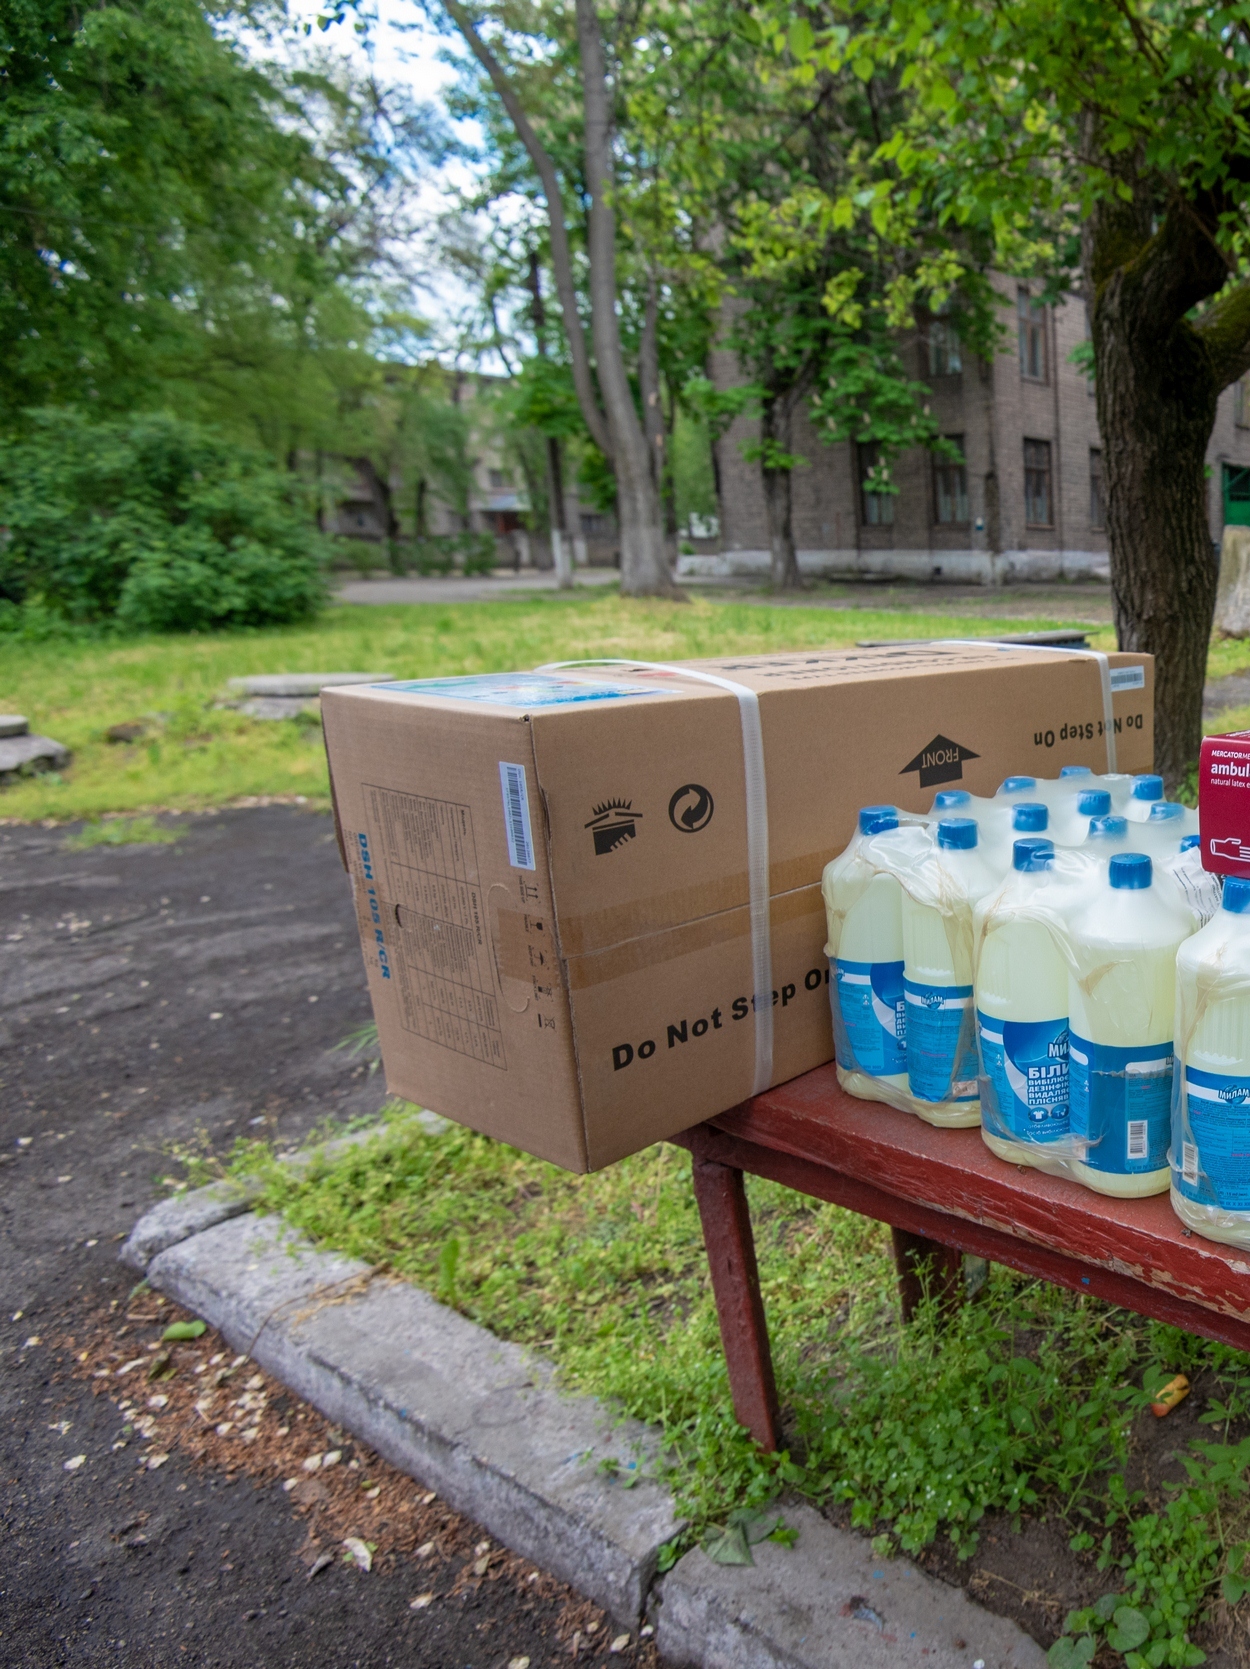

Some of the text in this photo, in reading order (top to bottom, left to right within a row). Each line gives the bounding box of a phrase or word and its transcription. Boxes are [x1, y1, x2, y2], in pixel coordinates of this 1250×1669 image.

[1060, 722, 1094, 741] Step
[1126, 714, 1143, 730] Do
[1034, 730, 1055, 748] On
[921, 747, 960, 769] FRONT
[1210, 778, 1231, 787] natural
[1232, 780, 1246, 789] latex
[356, 832, 377, 881] DSH
[366, 885, 382, 925] 105
[373, 929, 392, 980] R/CR
[610, 1036, 657, 1071] Do
[665, 1006, 723, 1049] Not
[1219, 1088, 1250, 1100] МИЛАМ
